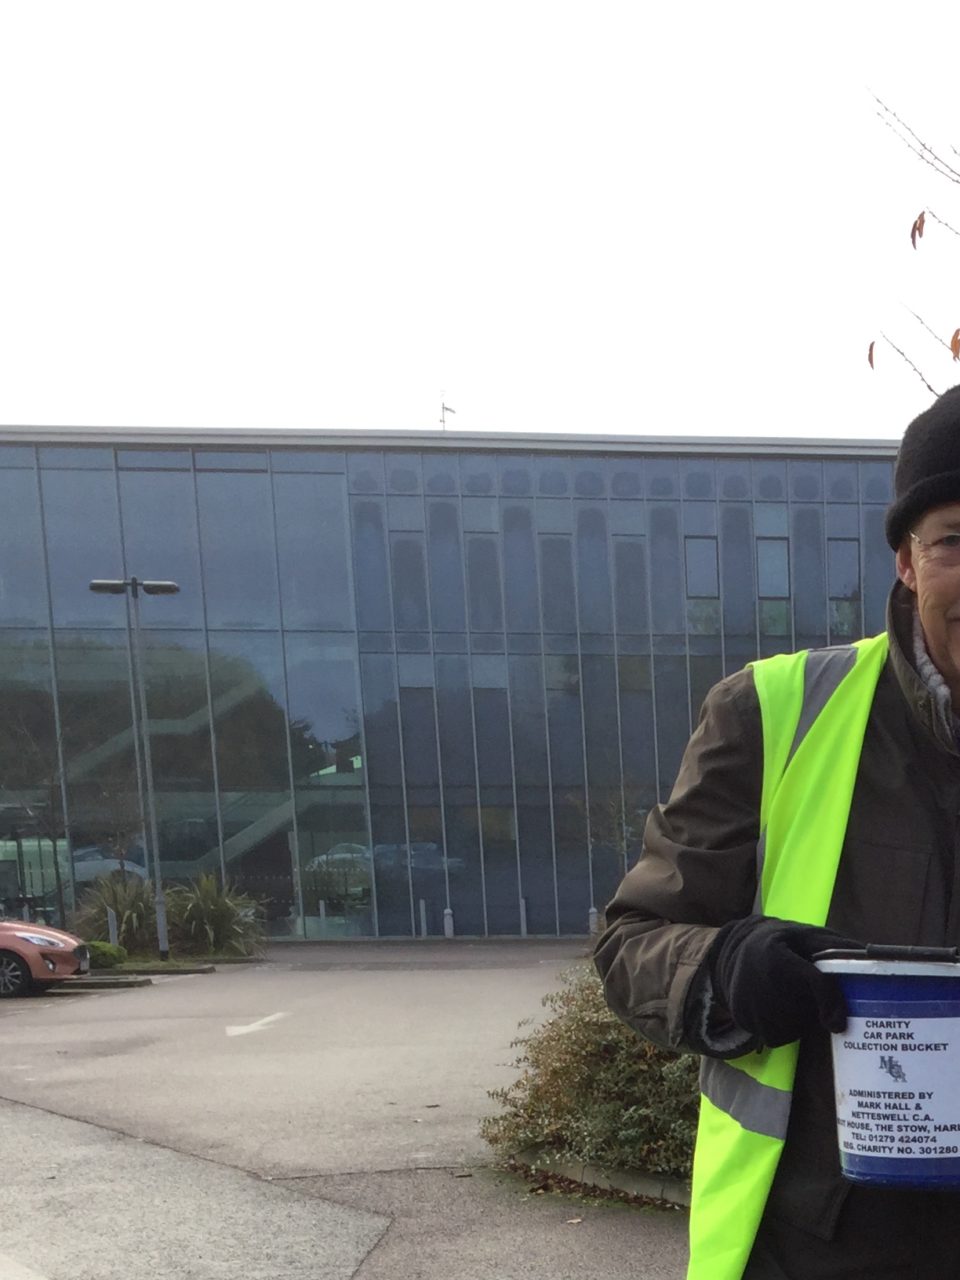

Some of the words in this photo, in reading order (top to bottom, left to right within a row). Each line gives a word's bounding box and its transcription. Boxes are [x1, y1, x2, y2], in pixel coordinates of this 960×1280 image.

[866, 1020, 911, 1028] CHARITY
[864, 1032, 882, 1040] CAR
[886, 1032, 914, 1040] PARK
[844, 1040, 898, 1051] COLLECTION
[901, 1043, 949, 1051] BUCKET
[849, 1089, 915, 1099] ADMINISTERED
[857, 1101, 881, 1110] MARK
[851, 1111, 909, 1122] NETTESWELL
[912, 1114, 934, 1122] C.A.
[847, 1120, 872, 1132] HOUSE,
[876, 1124, 893, 1132] THE
[896, 1124, 930, 1133] STOW,
[852, 1132, 866, 1141] TEL:
[868, 1134, 895, 1143] 01279
[857, 1144, 894, 1154] CHARITY
[918, 1145, 958, 1154] 301280
